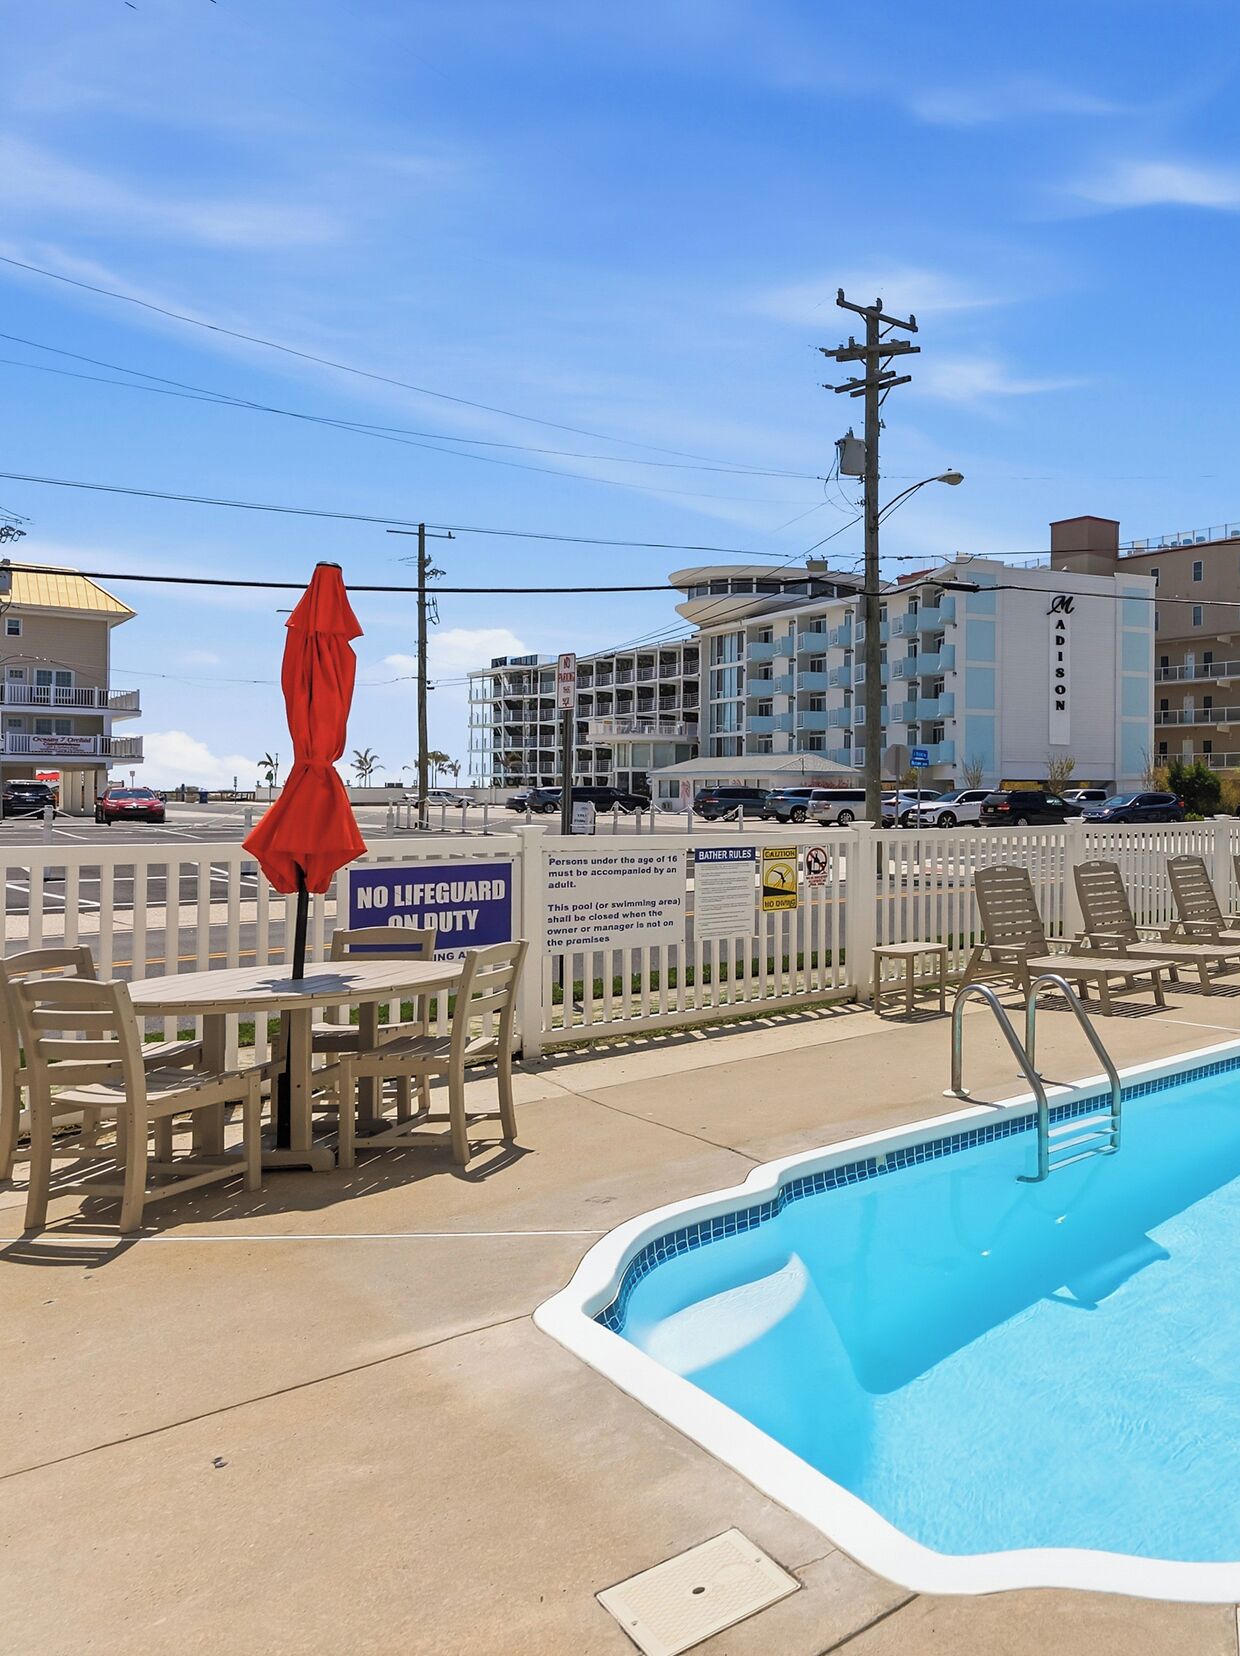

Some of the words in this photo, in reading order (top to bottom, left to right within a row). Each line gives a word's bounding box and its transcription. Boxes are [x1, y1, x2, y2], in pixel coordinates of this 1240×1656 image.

[1047, 595, 1075, 711] MADISON
[549, 858, 588, 866] Persons
[591, 857, 618, 865] under
[621, 856, 635, 864] the
[638, 857, 654, 865] age
[699, 850, 727, 860] BATHER
[729, 849, 752, 859] RULES
[591, 867, 651, 878] accompanied
[654, 867, 664, 875] by
[548, 881, 577, 889] adult.
[357, 886, 389, 909] NO
[394, 879, 505, 907] LIFEGUARD
[548, 904, 569, 912] This
[572, 902, 593, 915] pool
[595, 903, 609, 911] (or
[611, 899, 656, 908] swimming
[658, 898, 681, 907] area)
[388, 914, 418, 929] ON
[425, 909, 479, 933] DUTY
[547, 914, 571, 924] shall
[574, 914, 586, 922] be
[589, 912, 619, 921] closed
[622, 911, 646, 919] when
[547, 926, 578, 935] owner
[581, 925, 591, 933] or
[593, 922, 634, 934] manager
[646, 920, 661, 928] not
[547, 939, 563, 947] the
[566, 936, 610, 947] premises
